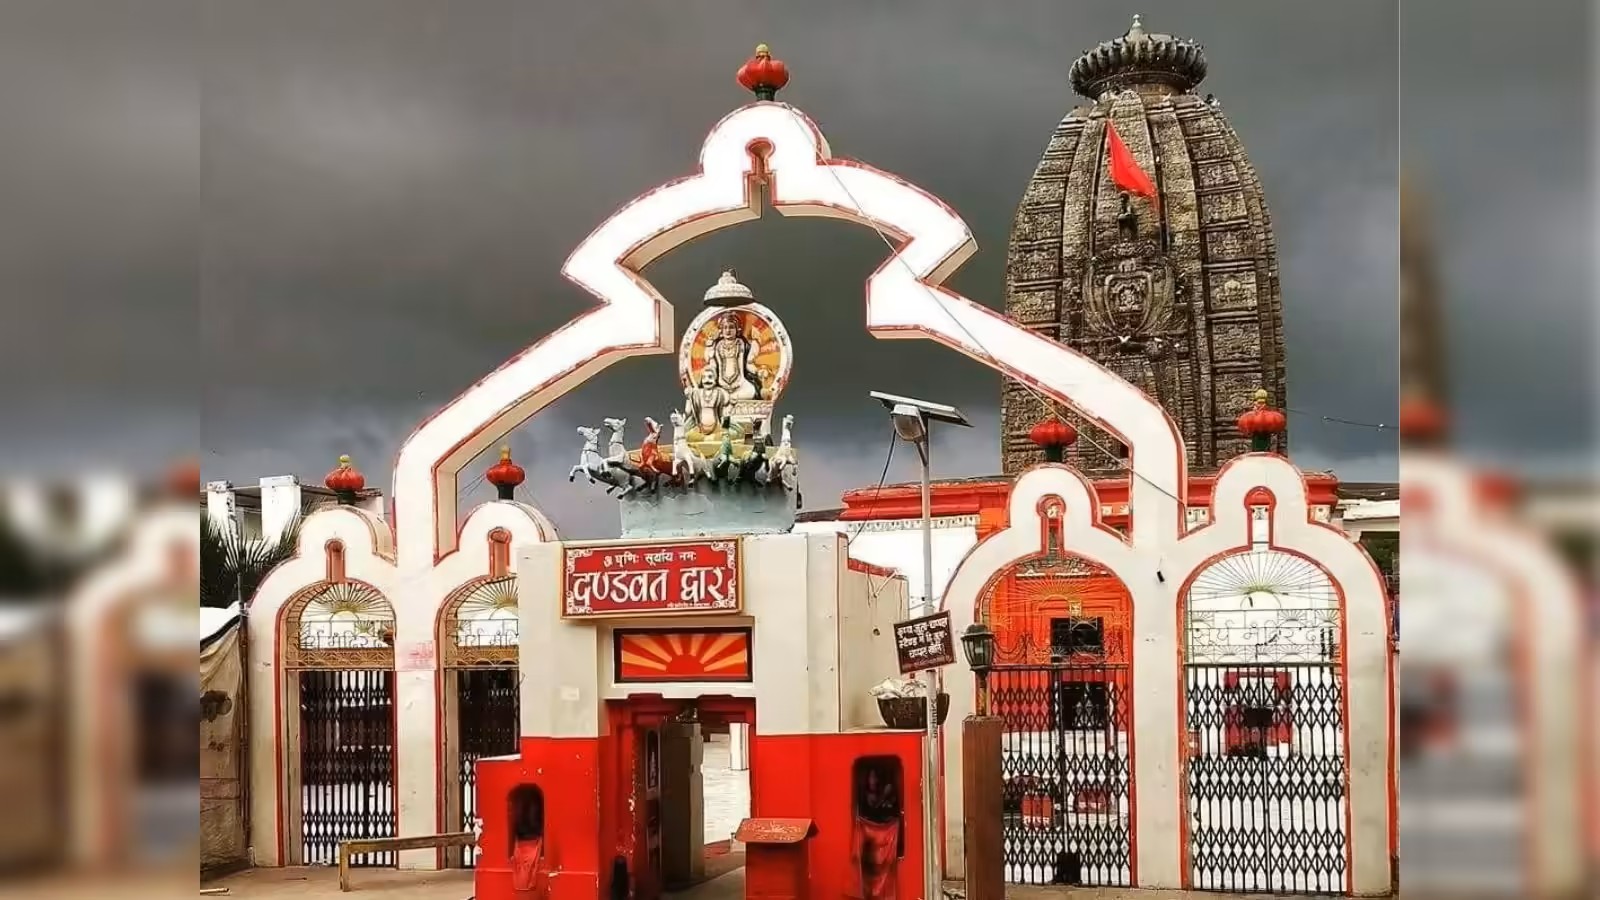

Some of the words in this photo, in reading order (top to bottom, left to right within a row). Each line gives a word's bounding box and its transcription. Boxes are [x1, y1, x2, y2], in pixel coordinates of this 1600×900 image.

[643, 549, 674, 567] सूर्याय
[573, 570, 669, 608] दण्डवत
[680, 566, 726, 604] द्वार
